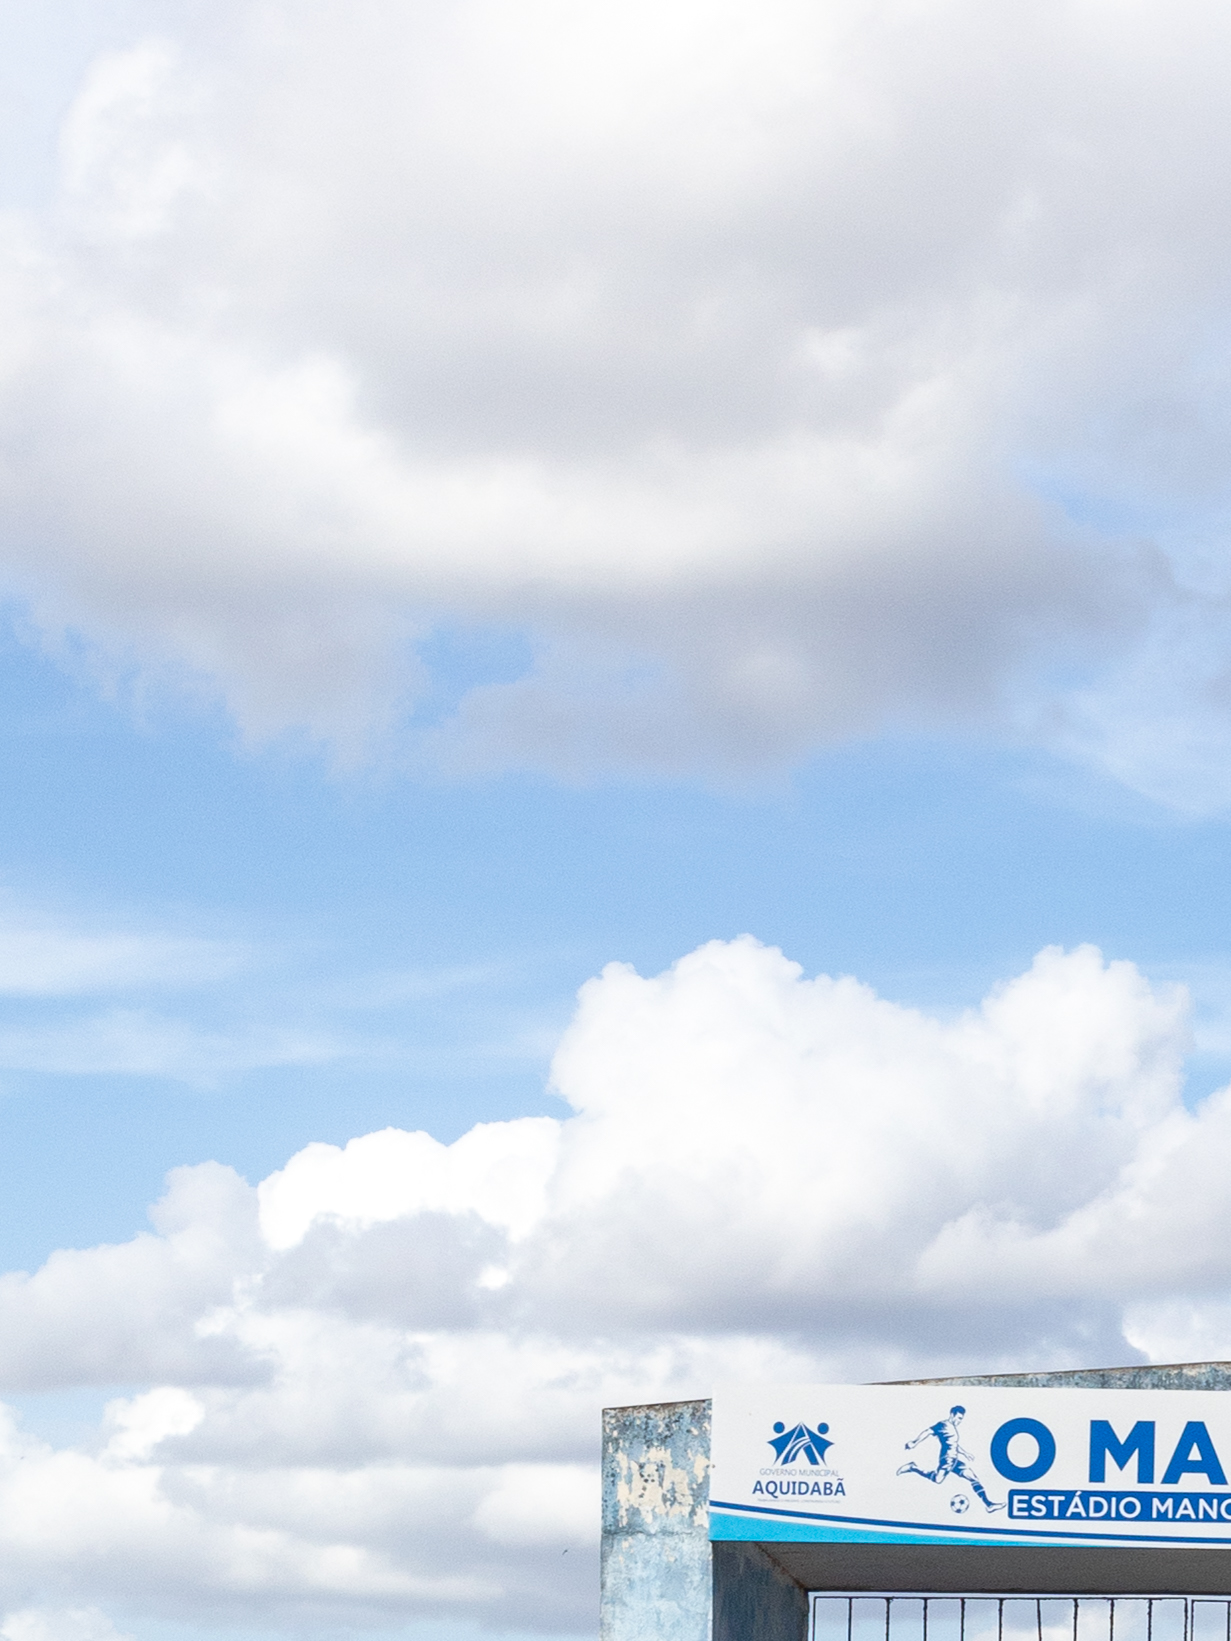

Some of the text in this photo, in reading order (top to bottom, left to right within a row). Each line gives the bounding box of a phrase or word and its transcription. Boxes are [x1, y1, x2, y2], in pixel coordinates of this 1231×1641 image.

[990, 1417, 1056, 1483] O
[759, 1468, 839, 1477] GOVERNO MUNICIPAL
[752, 1477, 846, 1499] AQUIDABÃ
[1011, 1490, 1142, 1518] ESTÁDIO
